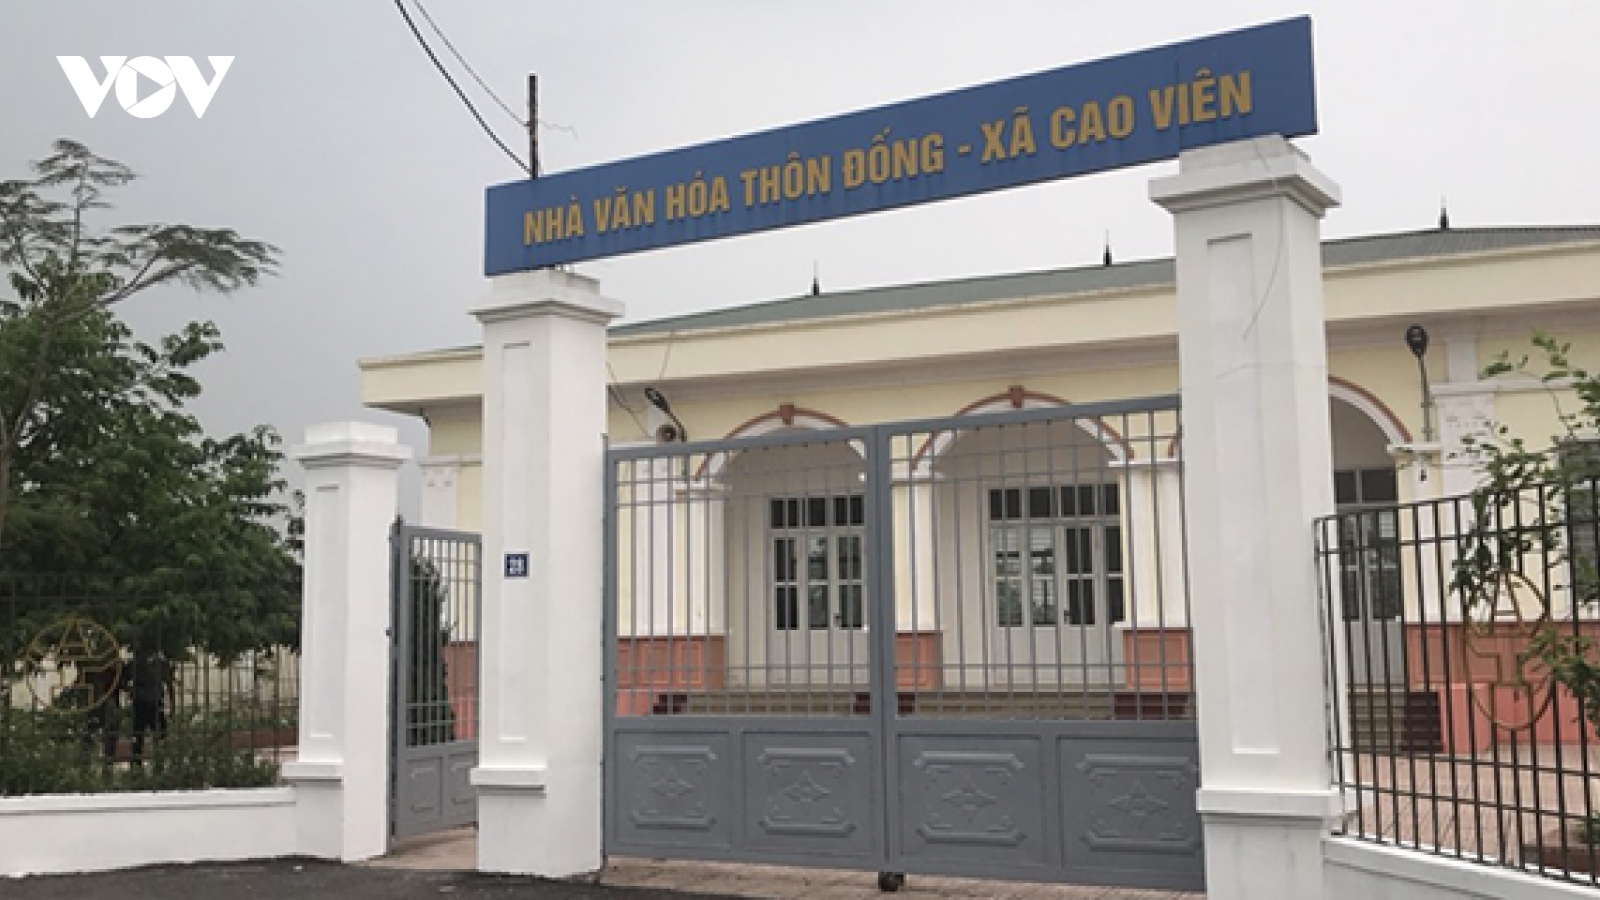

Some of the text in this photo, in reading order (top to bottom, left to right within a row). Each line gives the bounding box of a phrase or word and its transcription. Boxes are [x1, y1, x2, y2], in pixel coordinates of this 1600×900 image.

[523, 194, 584, 246] NHÀ
[593, 185, 655, 235] VĂN
[665, 170, 731, 221] HÓA
[740, 151, 831, 207] THÔN
[843, 126, 944, 189] ĐỐNG
[980, 106, 1036, 164] XÃ
[1049, 95, 1136, 151] CAO
[1148, 67, 1253, 132] VIÊN
